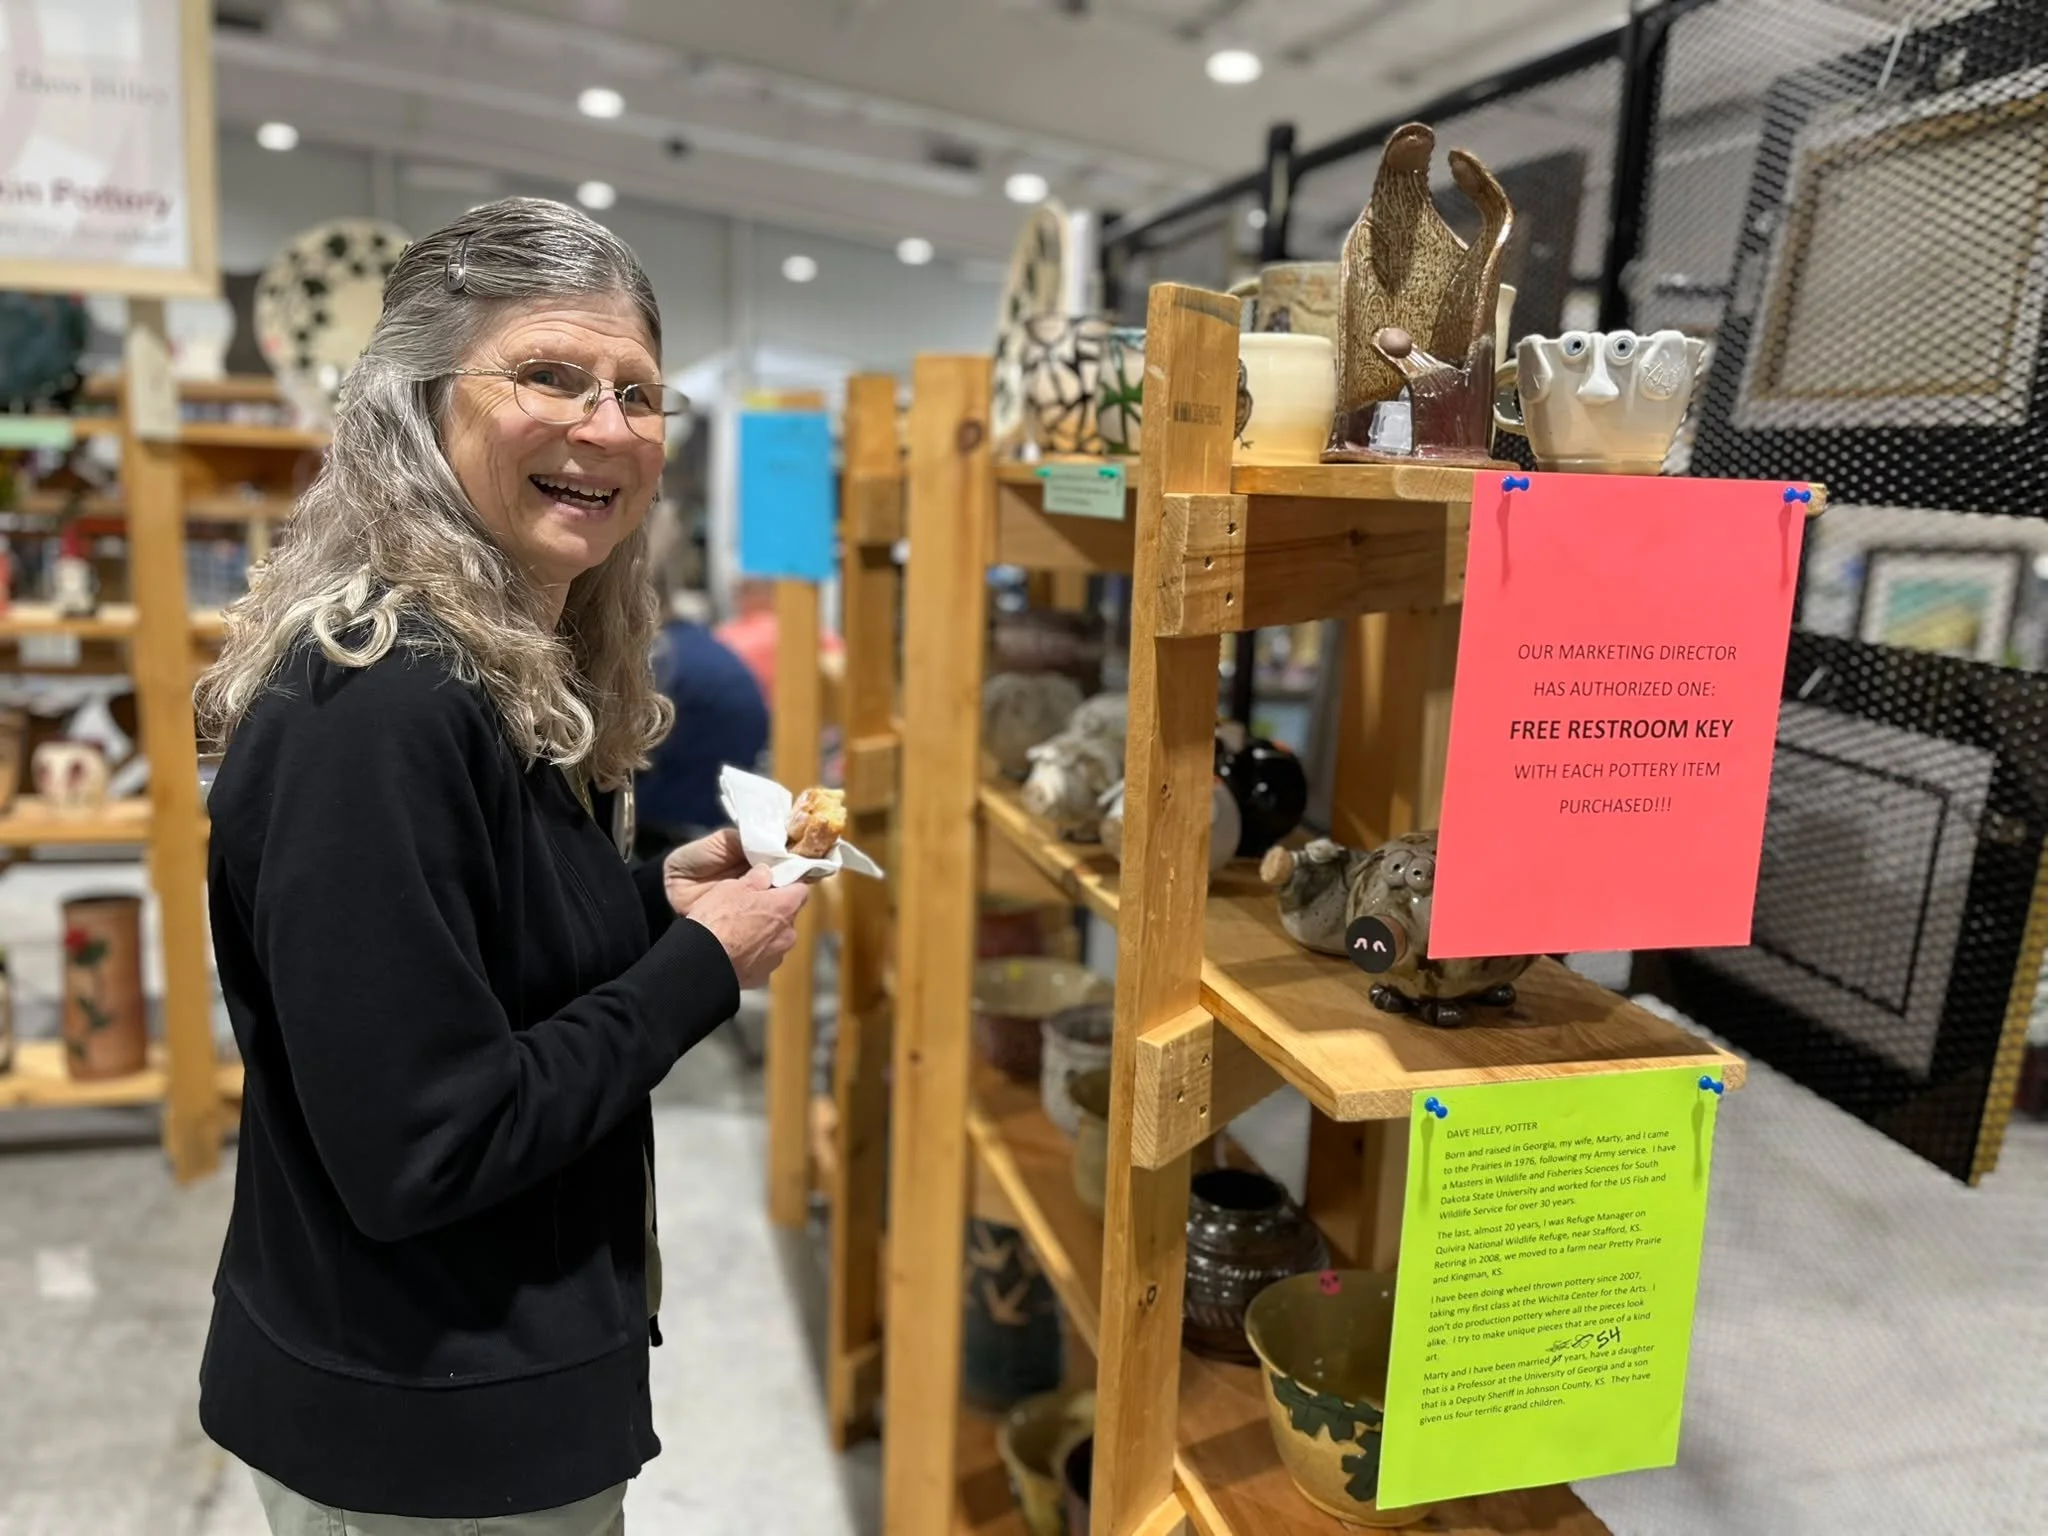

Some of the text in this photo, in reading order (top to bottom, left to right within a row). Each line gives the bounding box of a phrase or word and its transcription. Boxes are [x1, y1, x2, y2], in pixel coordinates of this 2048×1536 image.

[1518, 644, 1736, 660] OUR MARKETING DIRECTOR
[1533, 681, 1715, 696] HAS AUTHORIZED ONE:
[1509, 719, 1734, 740] FREE RESTROOM KEY
[1514, 761, 1720, 779] WITH EACH POTTERY ITEM
[1559, 796, 1671, 814] PURCHASED!!!
[1446, 1128, 1470, 1139] DAVE
[1504, 1121, 1538, 1132] POTTER
[1444, 1151, 1465, 1160] Born
[1467, 1147, 1483, 1157] and
[1484, 1144, 1511, 1155] raised
[1512, 1144, 1521, 1152] in
[1559, 1140, 1573, 1148] my
[1625, 1131, 1641, 1141] and
[1647, 1130, 1669, 1139] came
[1443, 1167, 1453, 1175] to
[1454, 1165, 1469, 1174] the
[1470, 1162, 1502, 1171] Prairies
[1539, 1153, 1577, 1164] following
[1579, 1152, 1592, 1160] my
[1593, 1150, 1616, 1158] Army
[1656, 1144, 1676, 1152] have
[1449, 1179, 1483, 1189] Masters
[1495, 1172, 1527, 1183] Wildlife
[1528, 1170, 1545, 1180] and
[1546, 1167, 1583, 1178] Fisheries
[1584, 1164, 1619, 1174] Sciences
[1621, 1161, 1633, 1170] for
[1635, 1159, 1659, 1169] South
[1440, 1172, 1666, 1205] Dakota State University and worked for the US Fish and
[1439, 1208, 1471, 1220] Wildlife
[1473, 1205, 1503, 1215] Service
[1504, 1202, 1517, 1211] for
[1518, 1201, 1538, 1210] over
[1540, 1198, 1550, 1208] 30
[1434, 1258, 1467, 1269] Retiring
[1518, 1247, 1547, 1258] moved
[1548, 1247, 1558, 1255] to
[1566, 1244, 1586, 1253] farm
[1587, 1242, 1607, 1250] near
[1608, 1239, 1634, 1248] Pretty
[1635, 1236, 1662, 1246] Prairie
[1435, 1244, 1466, 1255] Quivira
[1467, 1238, 1504, 1250] National
[1505, 1234, 1536, 1246] Wildlife
[1571, 1230, 1591, 1238] near
[1432, 1274, 1449, 1285] and
[1435, 1294, 1456, 1303] have
[1457, 1291, 1479, 1300] been
[1480, 1288, 1504, 1298] doing
[1506, 1283, 1531, 1294] wheel
[1532, 1281, 1562, 1291] thrown
[1564, 1277, 1595, 1288] pottery
[1596, 1274, 1618, 1283] since
[1427, 1298, 1644, 1333] don't do production pottery where all the pieces look
[1429, 1308, 1455, 1319] taking
[1456, 1307, 1470, 1315] my
[1472, 1303, 1488, 1312] first
[1490, 1301, 1510, 1310] class
[1511, 1299, 1520, 1307] at
[1522, 1297, 1536, 1306] the
[1538, 1294, 1569, 1303] Wichita
[1571, 1291, 1598, 1300] Center
[1600, 1288, 1612, 1296] for
[1614, 1287, 1628, 1295] the
[1457, 1335, 1470, 1343] try
[1471, 1333, 1481, 1341] to
[1482, 1329, 1505, 1340] make
[1507, 1326, 1535, 1336] unique
[1537, 1323, 1563, 1334] pieces
[1564, 1320, 1582, 1328] that
[1598, 1317, 1614, 1325] one
[1615, 1313, 1625, 1323] of
[1633, 1311, 1651, 1320] kind
[1597, 1326, 1620, 1349] 54
[1423, 1371, 1449, 1381] Marty
[1450, 1367, 1467, 1377] and
[1473, 1365, 1493, 1374] have
[1494, 1362, 1516, 1371] been
[1517, 1358, 1550, 1368] married
[1617, 1345, 1655, 1355] daughter
[1419, 1415, 1442, 1426] given
[1455, 1408, 1473, 1418] four
[1474, 1405, 1502, 1416] terrific
[1503, 1400, 1528, 1413] grand
